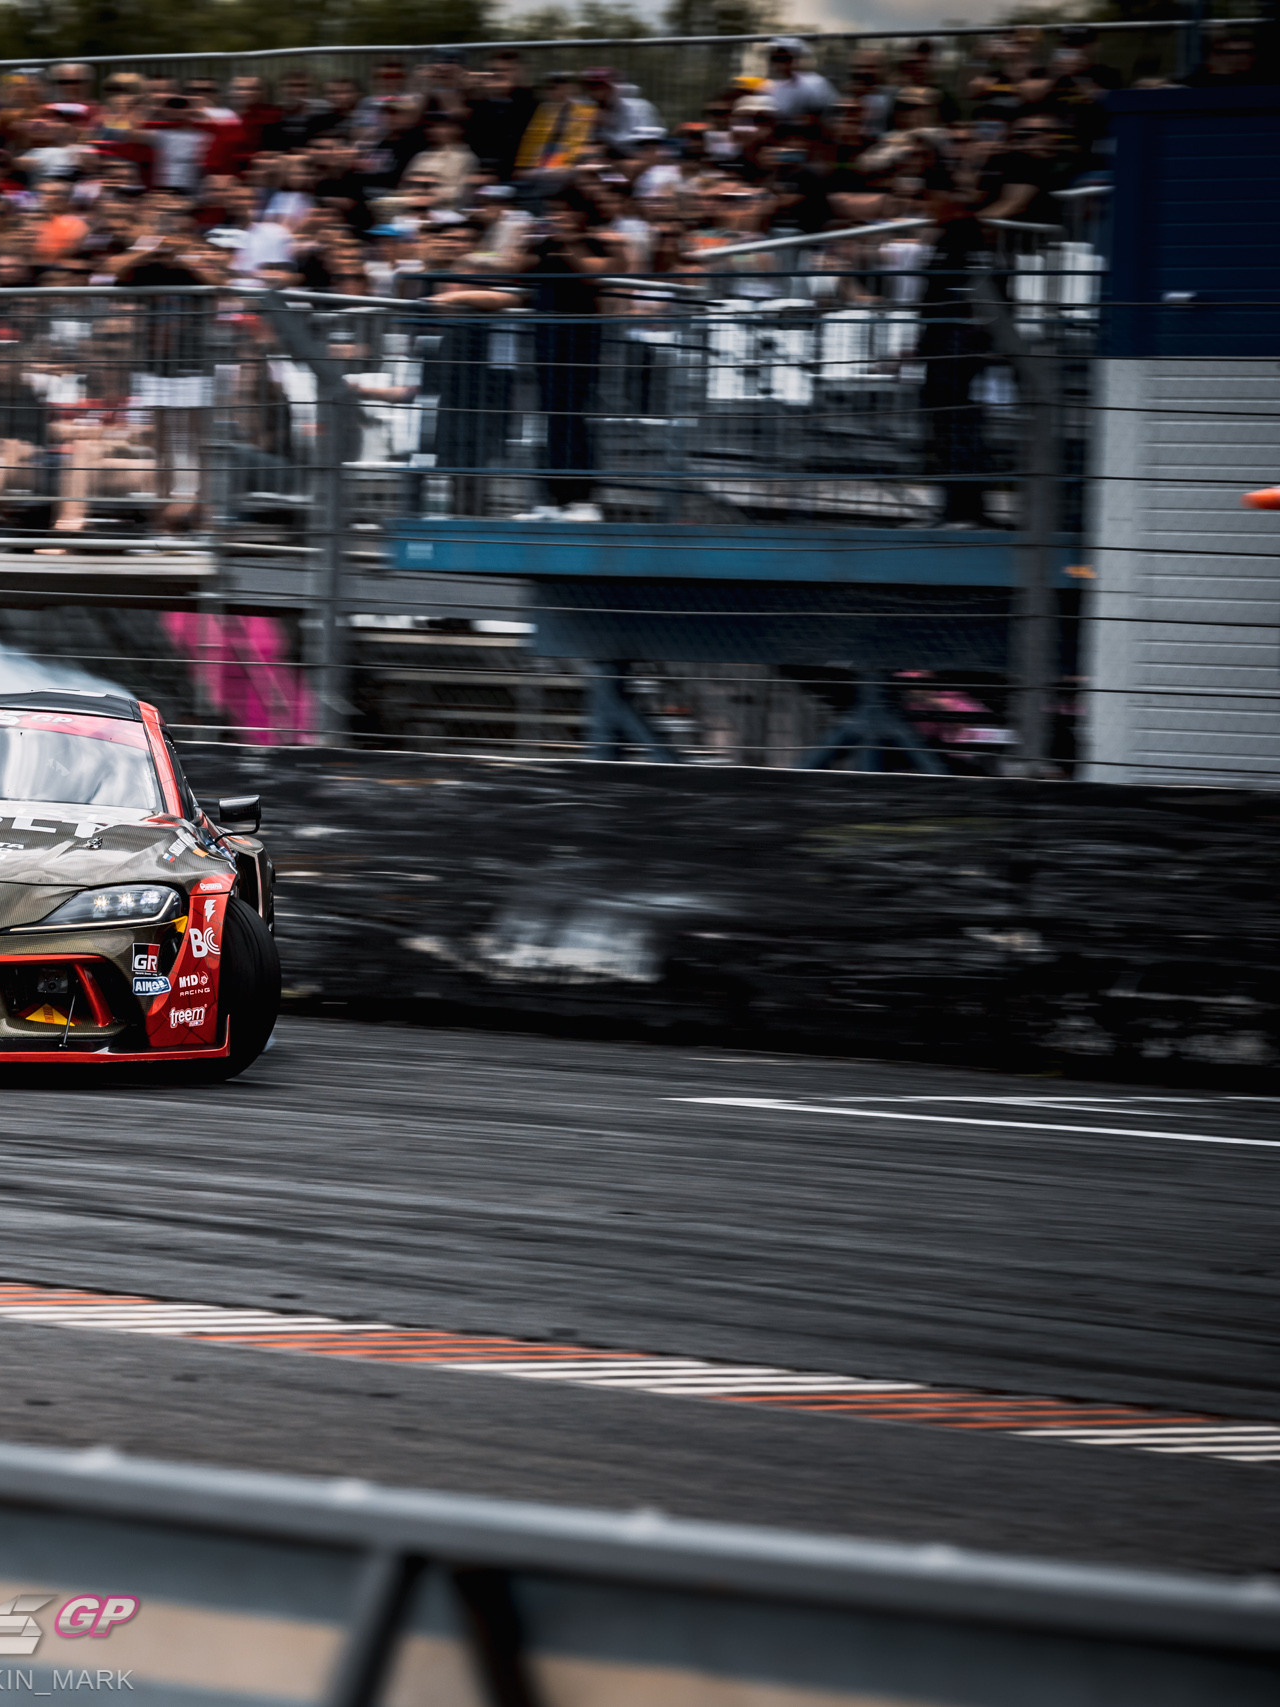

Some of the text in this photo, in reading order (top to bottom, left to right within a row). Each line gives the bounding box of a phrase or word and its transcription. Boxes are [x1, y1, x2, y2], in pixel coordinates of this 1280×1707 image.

[31, 714, 73, 724] GP
[134, 954, 157, 970] GR
[180, 987, 211, 996] RACING
[170, 1007, 206, 1028] freem
